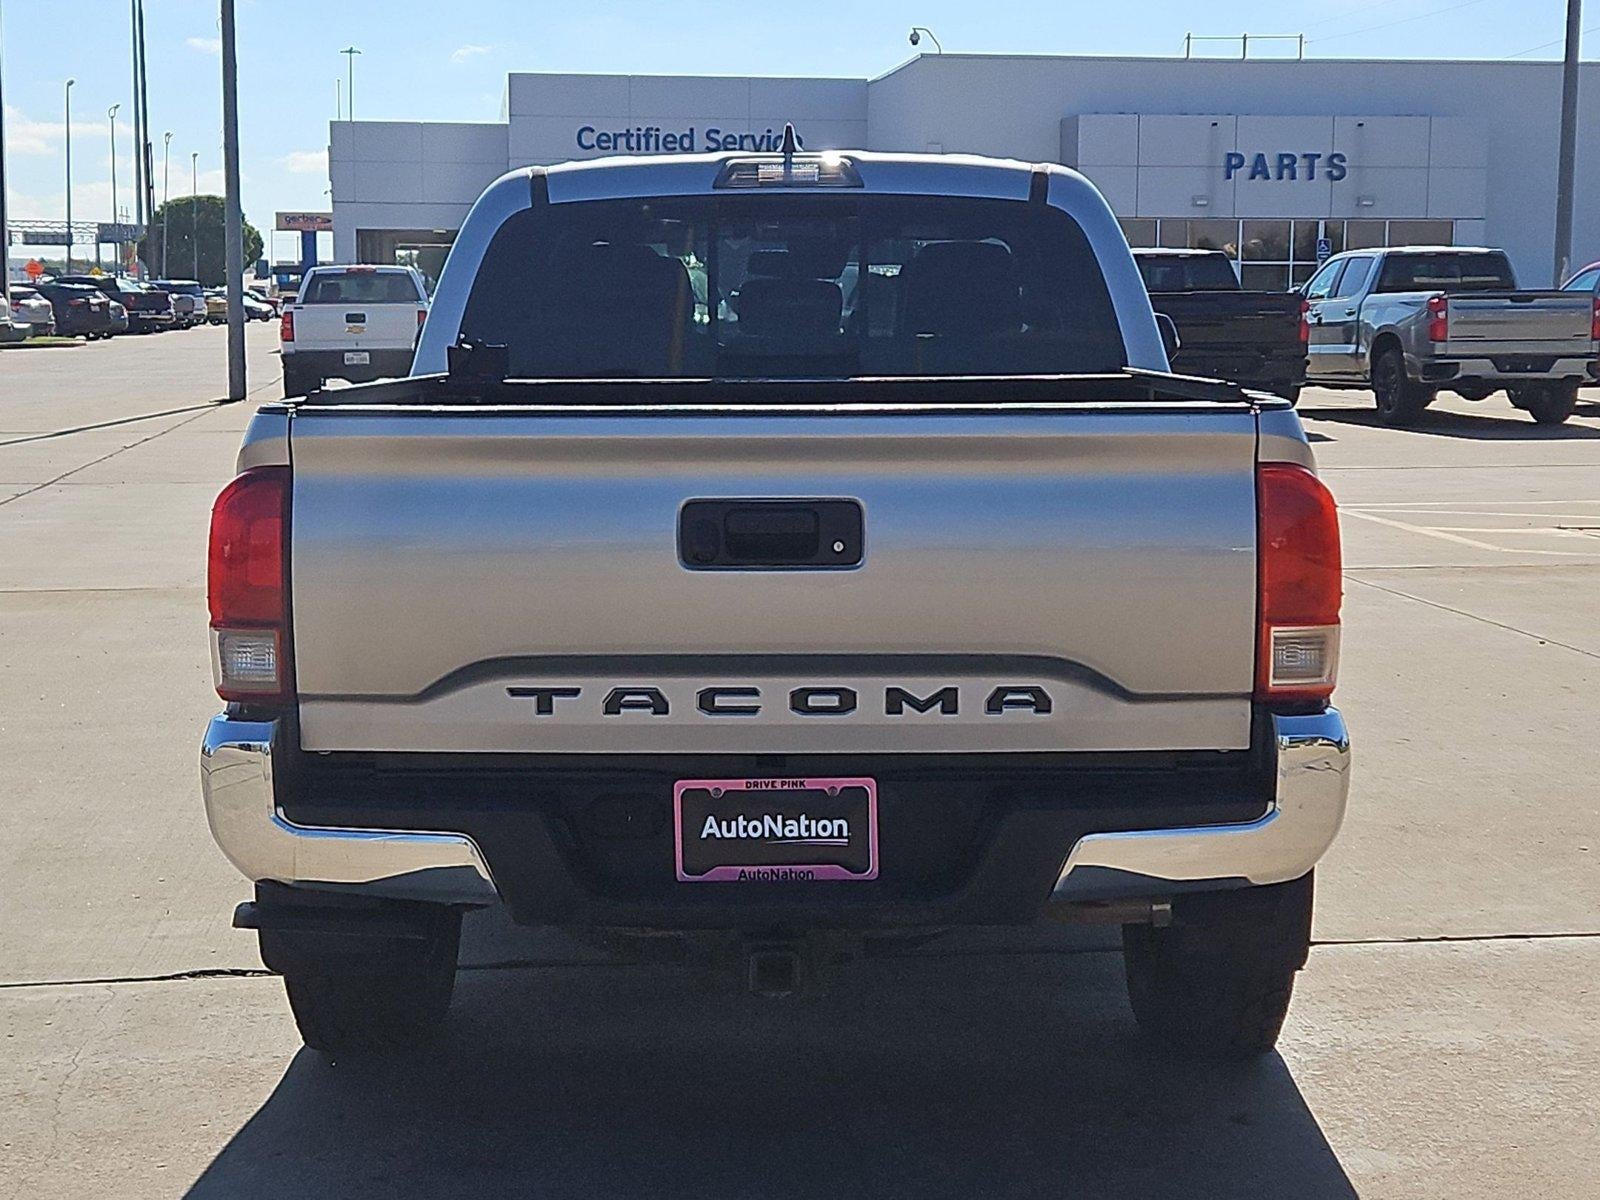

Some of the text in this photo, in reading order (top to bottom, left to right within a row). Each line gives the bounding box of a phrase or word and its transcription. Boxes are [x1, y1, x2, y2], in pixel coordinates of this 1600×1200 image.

[577, 126, 695, 151] Certified
[1225, 152, 1347, 182] PARTS
[506, 686, 1053, 716] TACOMA
[745, 780, 806, 789] DRIVE PINK
[700, 814, 849, 839] AutoNation
[738, 868, 814, 882] AutoNation
